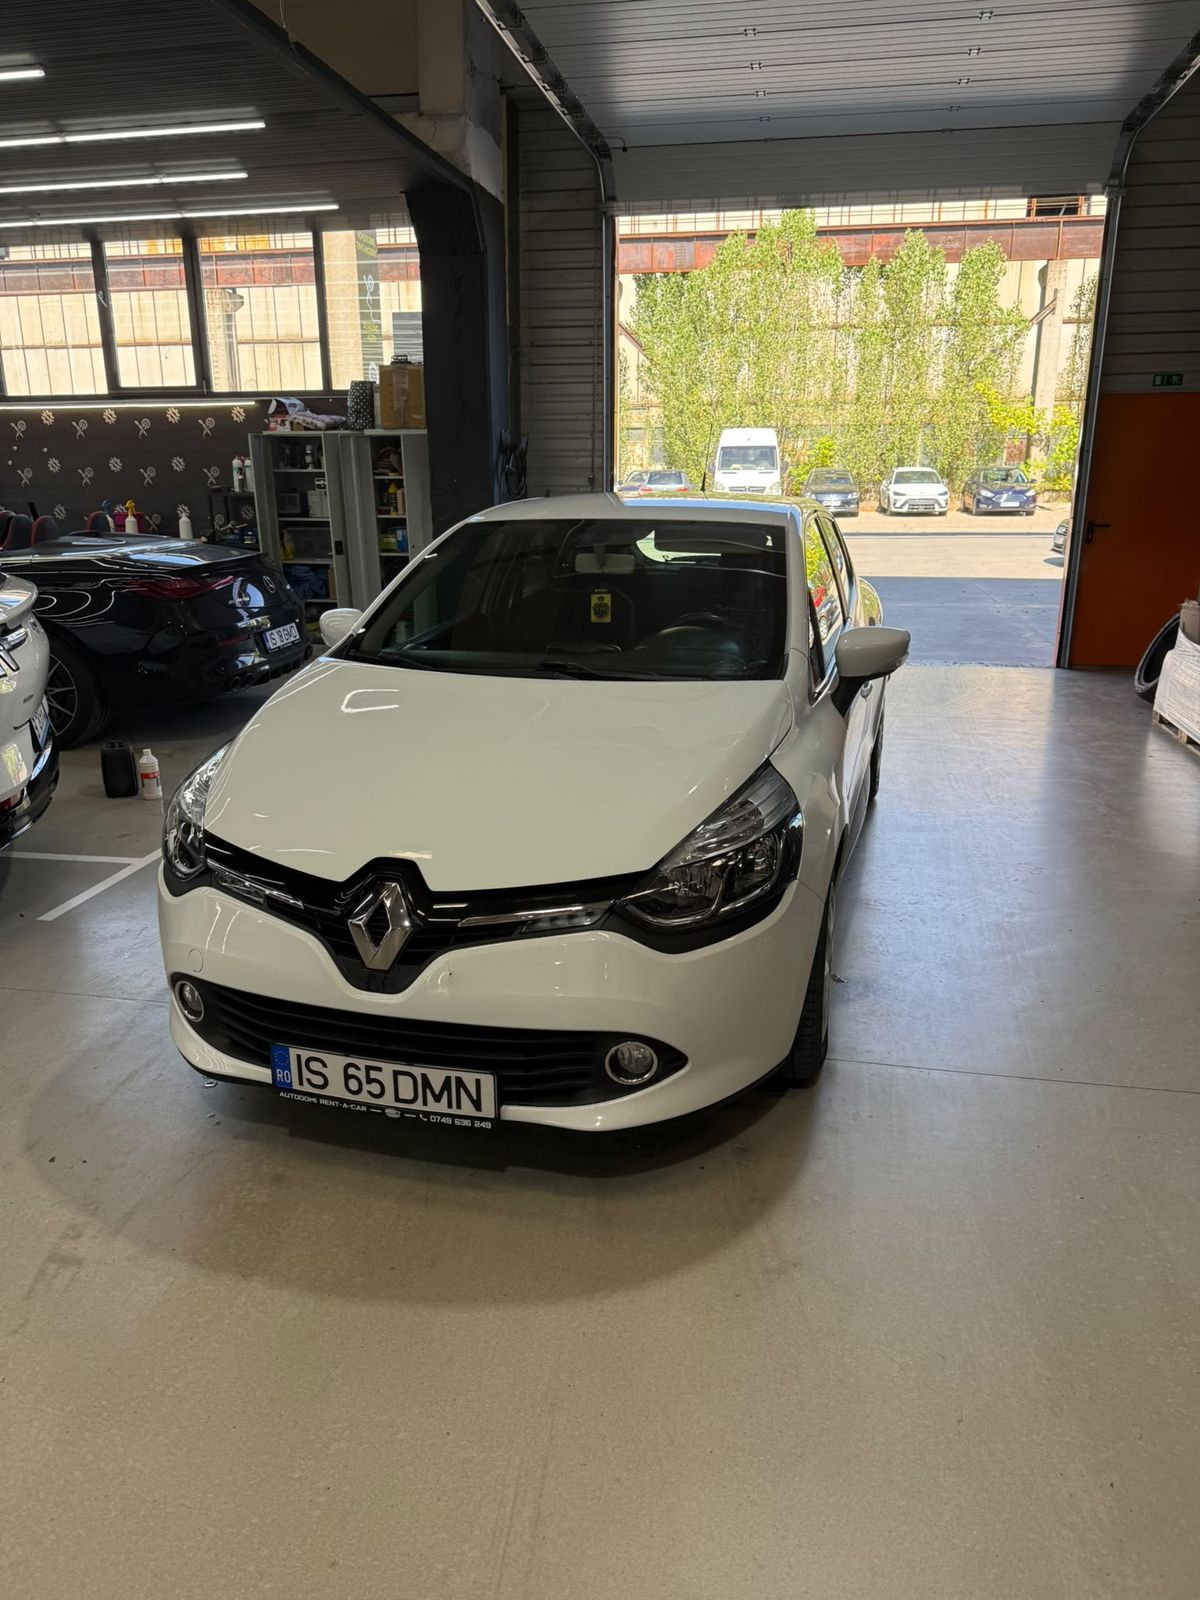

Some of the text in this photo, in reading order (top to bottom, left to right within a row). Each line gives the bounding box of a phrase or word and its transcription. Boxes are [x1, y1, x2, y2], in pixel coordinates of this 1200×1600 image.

[276, 1068, 291, 1083] RO
[296, 1053, 482, 1112] IS 65 DMN
[279, 1091, 317, 1103] AUTODOMI
[319, 1098, 367, 1112] RENT-A-CAR
[429, 1115, 452, 1124] 0749
[474, 1120, 492, 1129] 249
